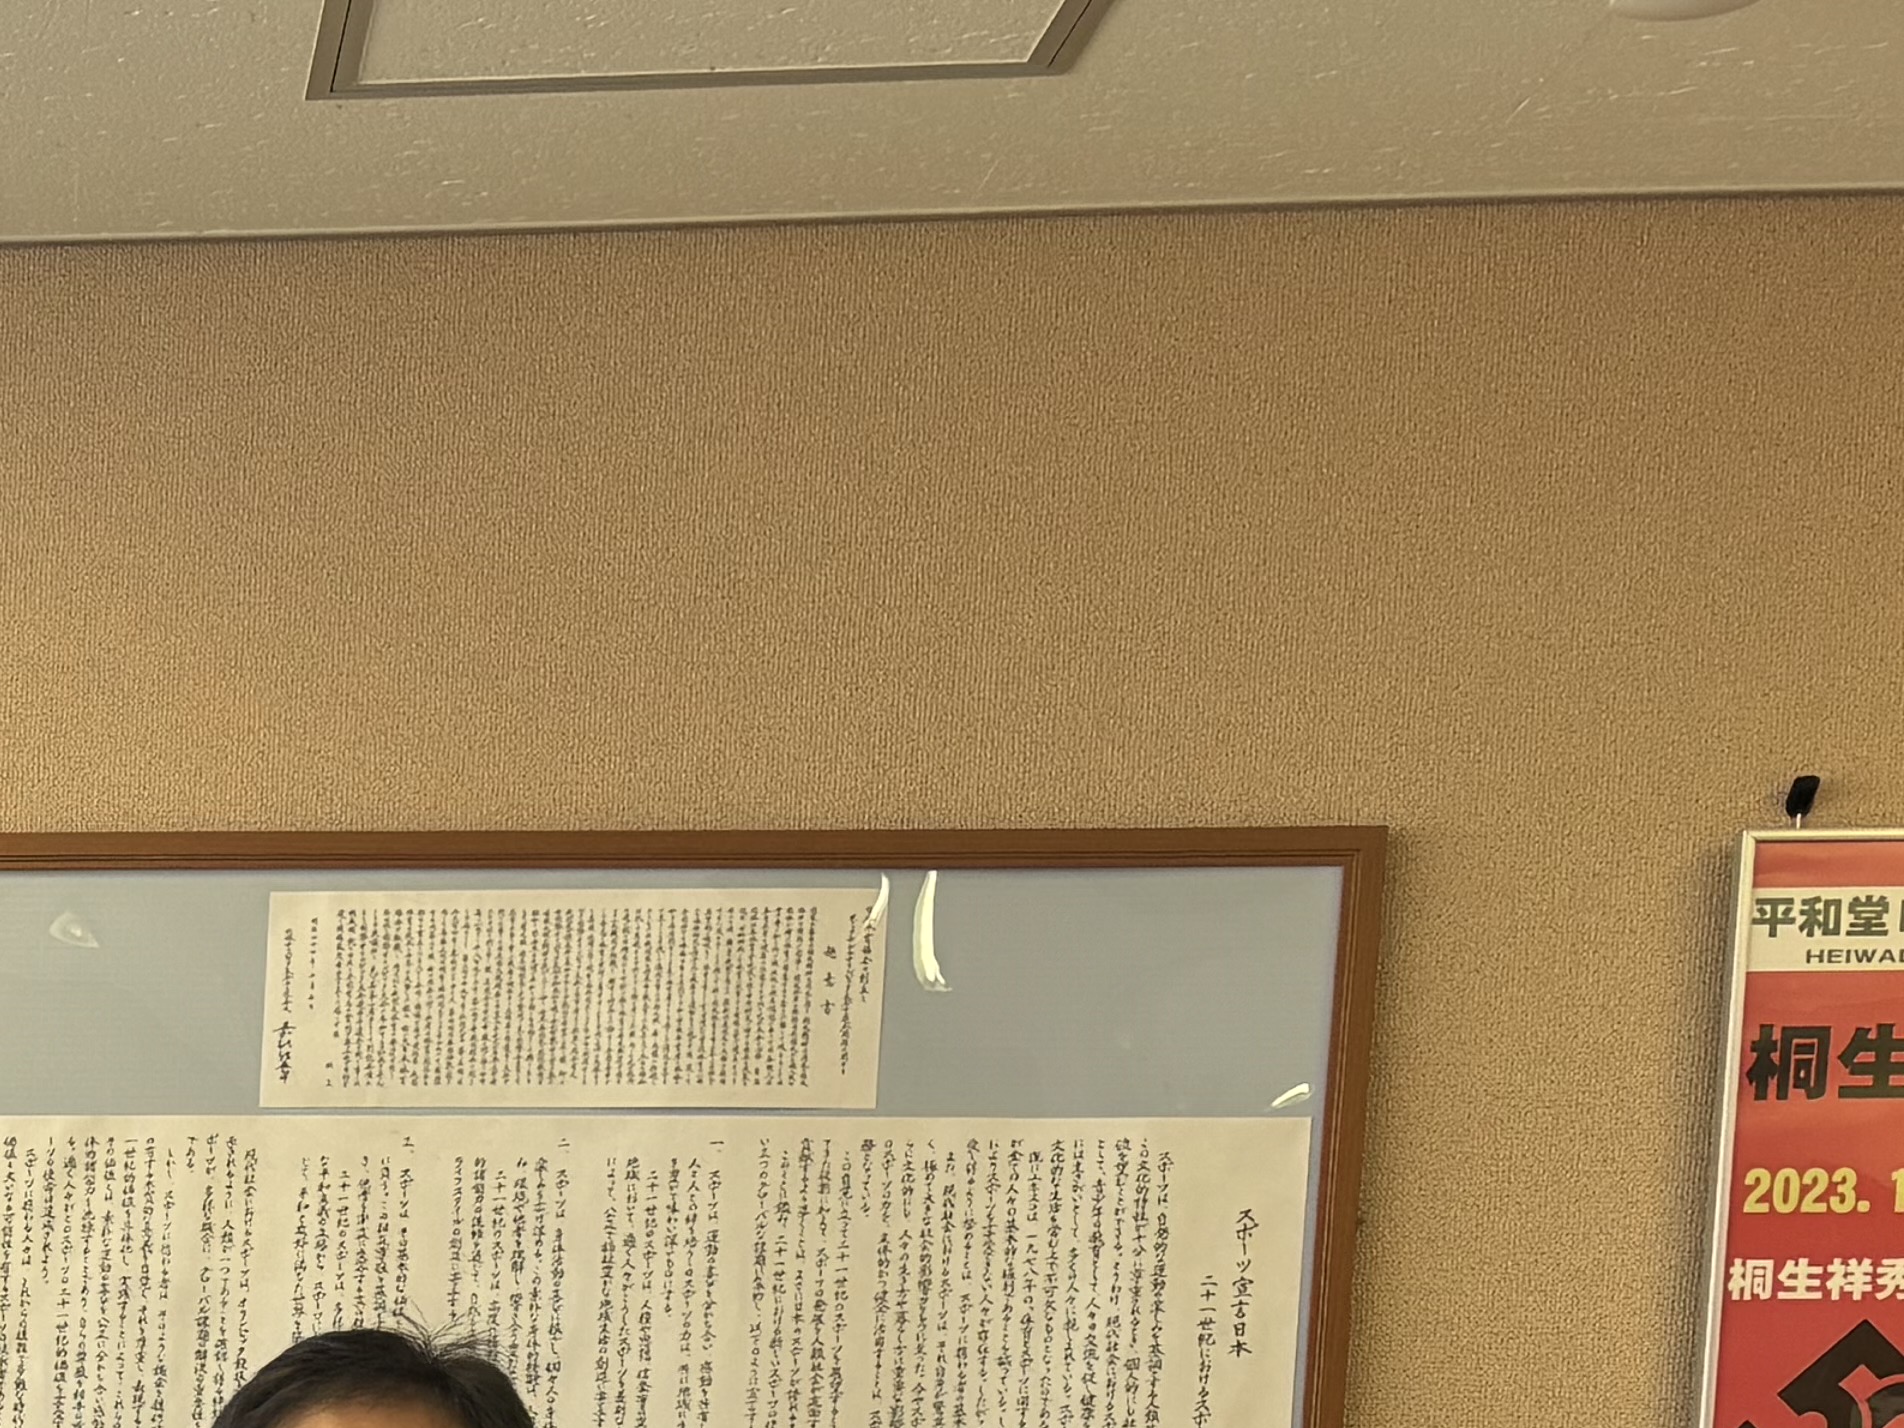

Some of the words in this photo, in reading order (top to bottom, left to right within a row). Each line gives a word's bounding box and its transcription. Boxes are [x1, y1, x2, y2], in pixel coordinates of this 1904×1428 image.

[1750, 896, 1904, 939] 平和堂
[1743, 1167, 1871, 1214] 2023.
[1226, 1207, 1260, 1358] スポーツ宣言日本
